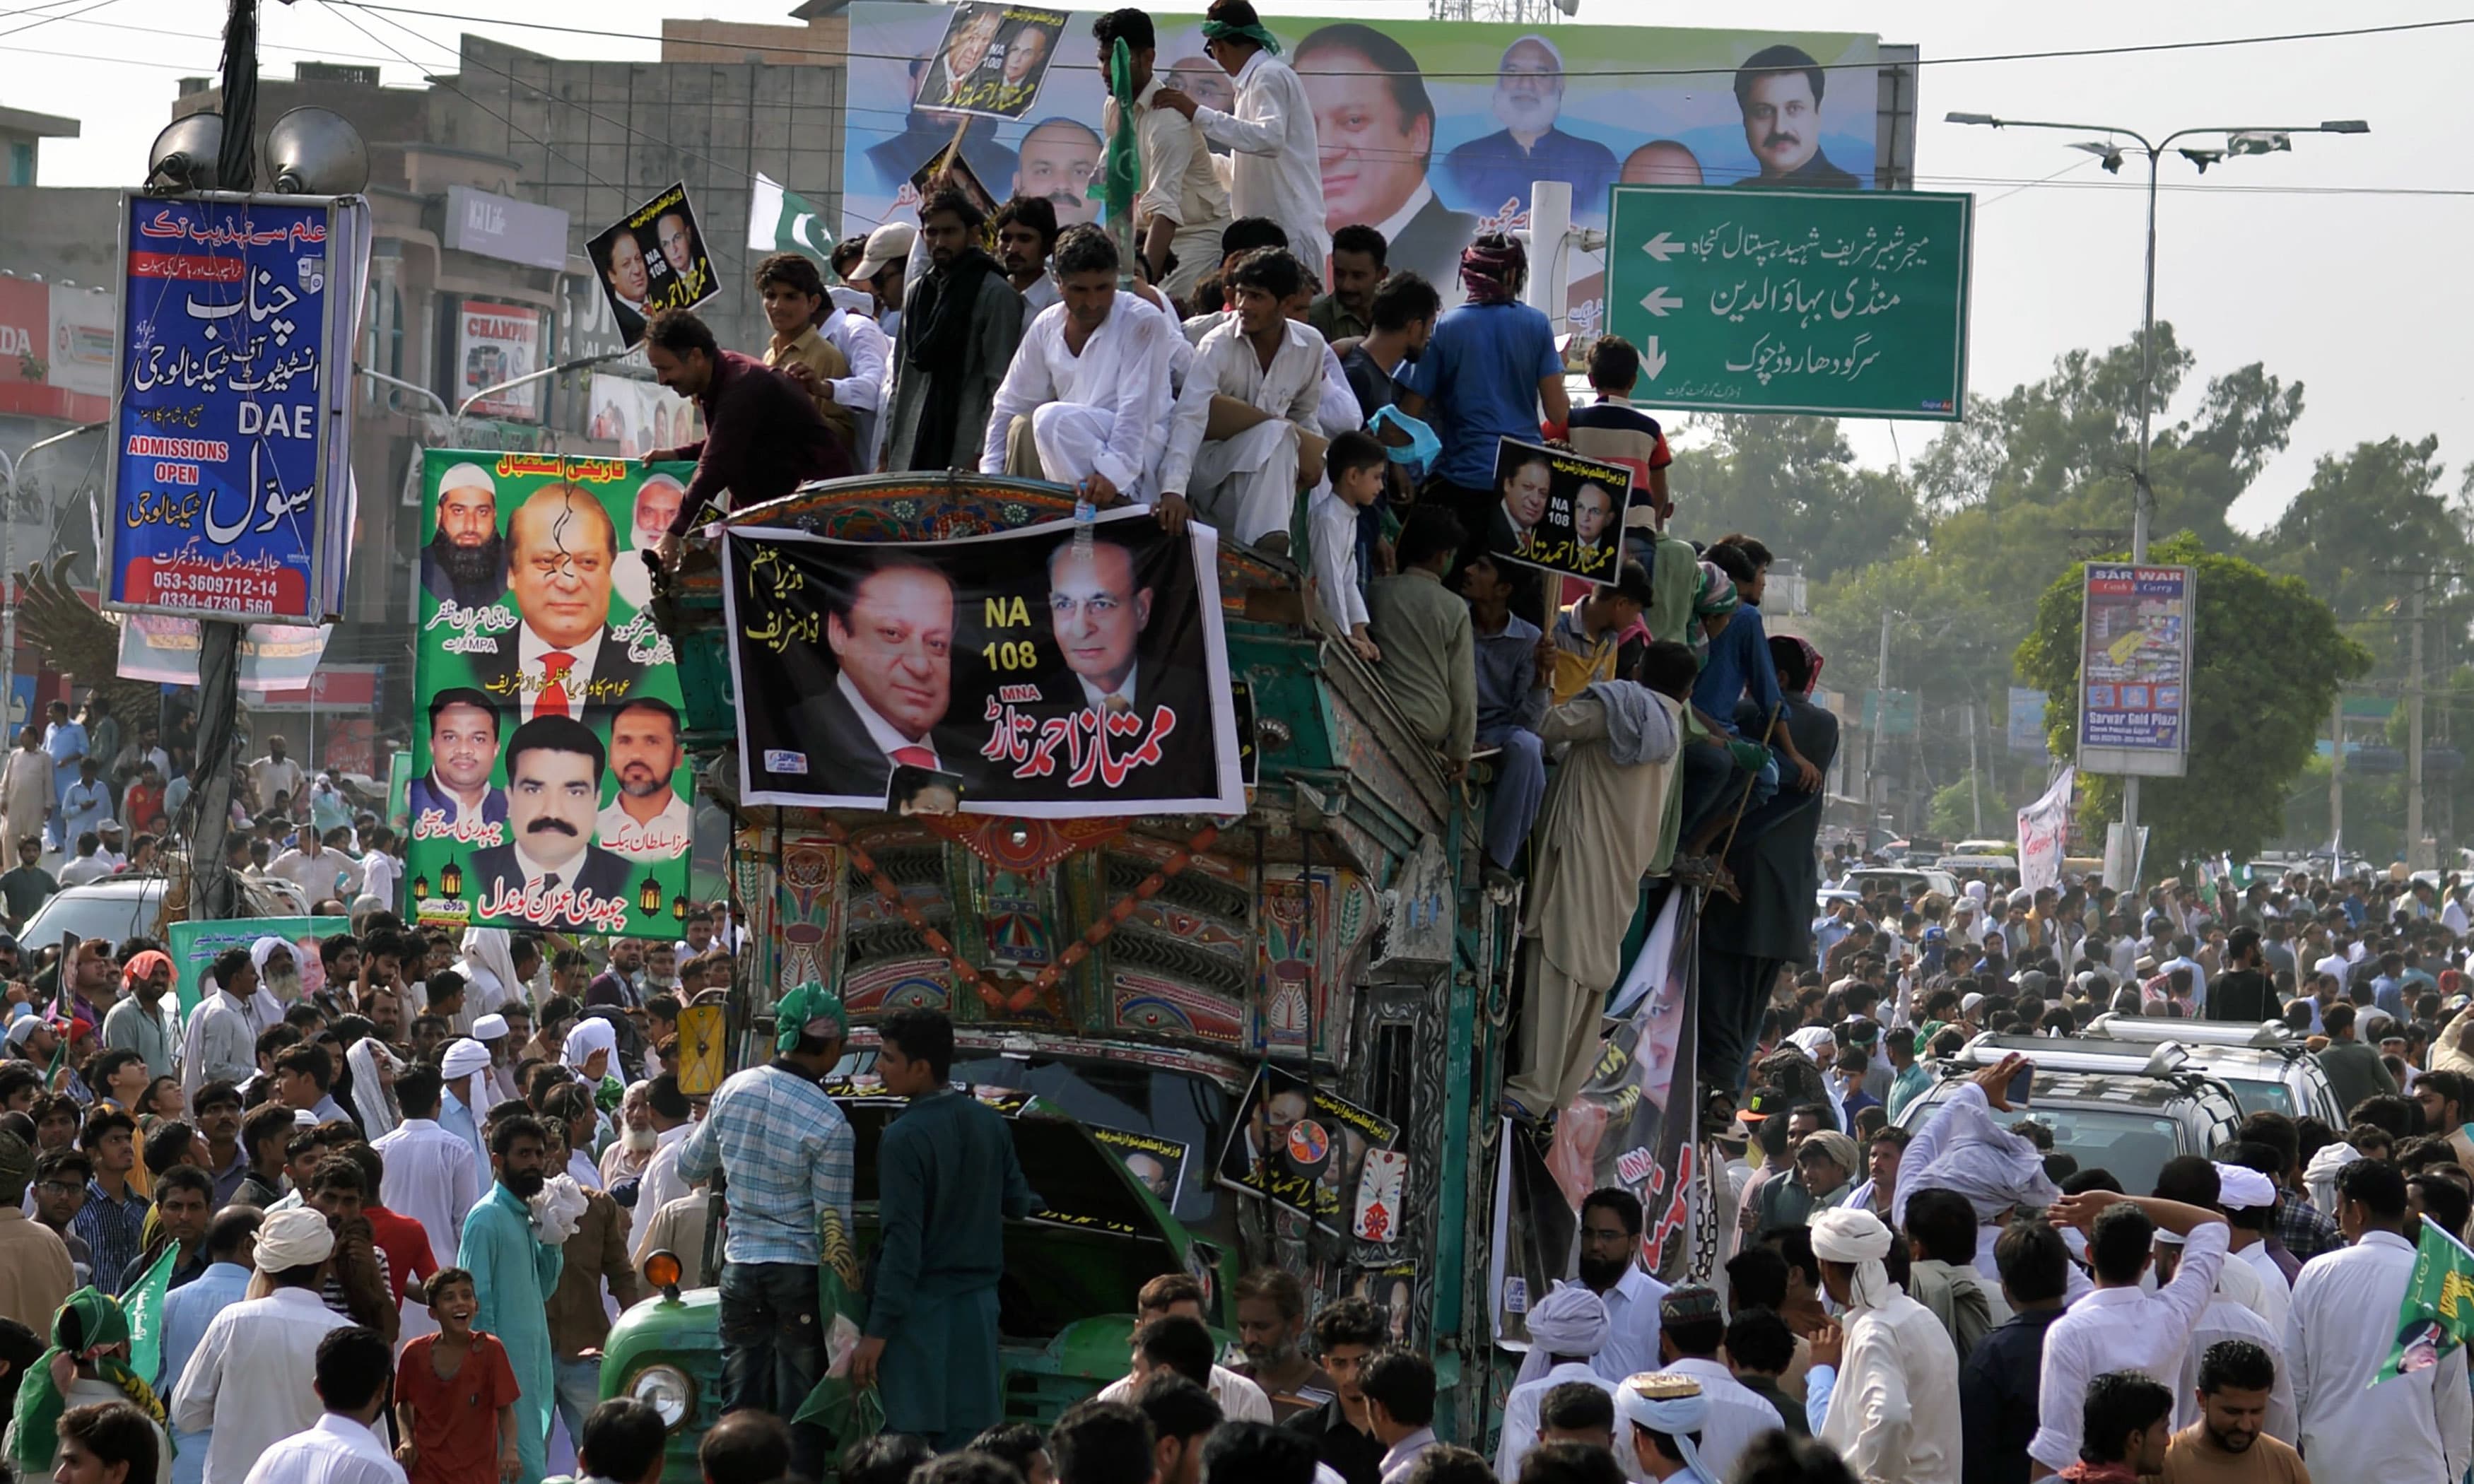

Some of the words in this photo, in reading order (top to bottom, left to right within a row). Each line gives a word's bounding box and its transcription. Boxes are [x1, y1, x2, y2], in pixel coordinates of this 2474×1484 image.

[141, 209, 188, 239] تک
[189, 216, 254, 249] تہذیب
[250, 227, 287, 245] سے
[290, 216, 327, 253] علم
[645, 248, 662, 266] NA
[1722, 225, 1781, 267] ہسپتال
[1777, 226, 1820, 266] شہید
[1820, 226, 1878, 266] شریف
[1894, 236, 1930, 272] میجر
[186, 264, 298, 347] چناب
[1829, 276, 1901, 321] منڈی
[230, 336, 268, 362] آف
[1725, 332, 1776, 386] چوک
[1773, 341, 1805, 375] روڈ
[1807, 331, 1882, 382] سرگودھا
[134, 344, 230, 392] ٹیکنالوجی
[239, 401, 314, 439] DAE
[127, 435, 229, 463] ADMISSIONS
[155, 463, 199, 485] OPEN
[567, 459, 626, 483] تاریخی
[126, 493, 201, 529] ٹیکنالوجی
[1548, 512, 1570, 527] 108
[1551, 497, 1569, 512] NA
[152, 535, 201, 572] گجرات
[153, 571, 278, 597] 053-3609712-14
[2094, 570, 2133, 580] SAR
[2138, 570, 2182, 582] WAR
[424, 599, 457, 630] ظفر
[450, 606, 490, 632] عمران
[485, 605, 518, 631] حاجی
[985, 596, 1032, 628] NA
[468, 637, 498, 654] MPA
[983, 640, 1038, 671] 108
[485, 669, 524, 697] شریف
[601, 678, 631, 705] عوام
[999, 684, 1043, 703] MNA
[980, 694, 1037, 762] تارڑ
[2089, 712, 2126, 725] Sarwar
[2128, 712, 2149, 725] Gold
[2151, 712, 2177, 726] Plaza
[1013, 712, 1081, 779] احمد
[1067, 702, 1176, 788] ممتاز
[602, 823, 631, 852] بیگ
[630, 831, 672, 852] سلطان
[672, 833, 691, 857] مرزا
[477, 875, 543, 919] گوندل
[525, 888, 575, 927] عمران
[566, 887, 628, 931] چوہدری
[1617, 1146, 1653, 1184] MNA
